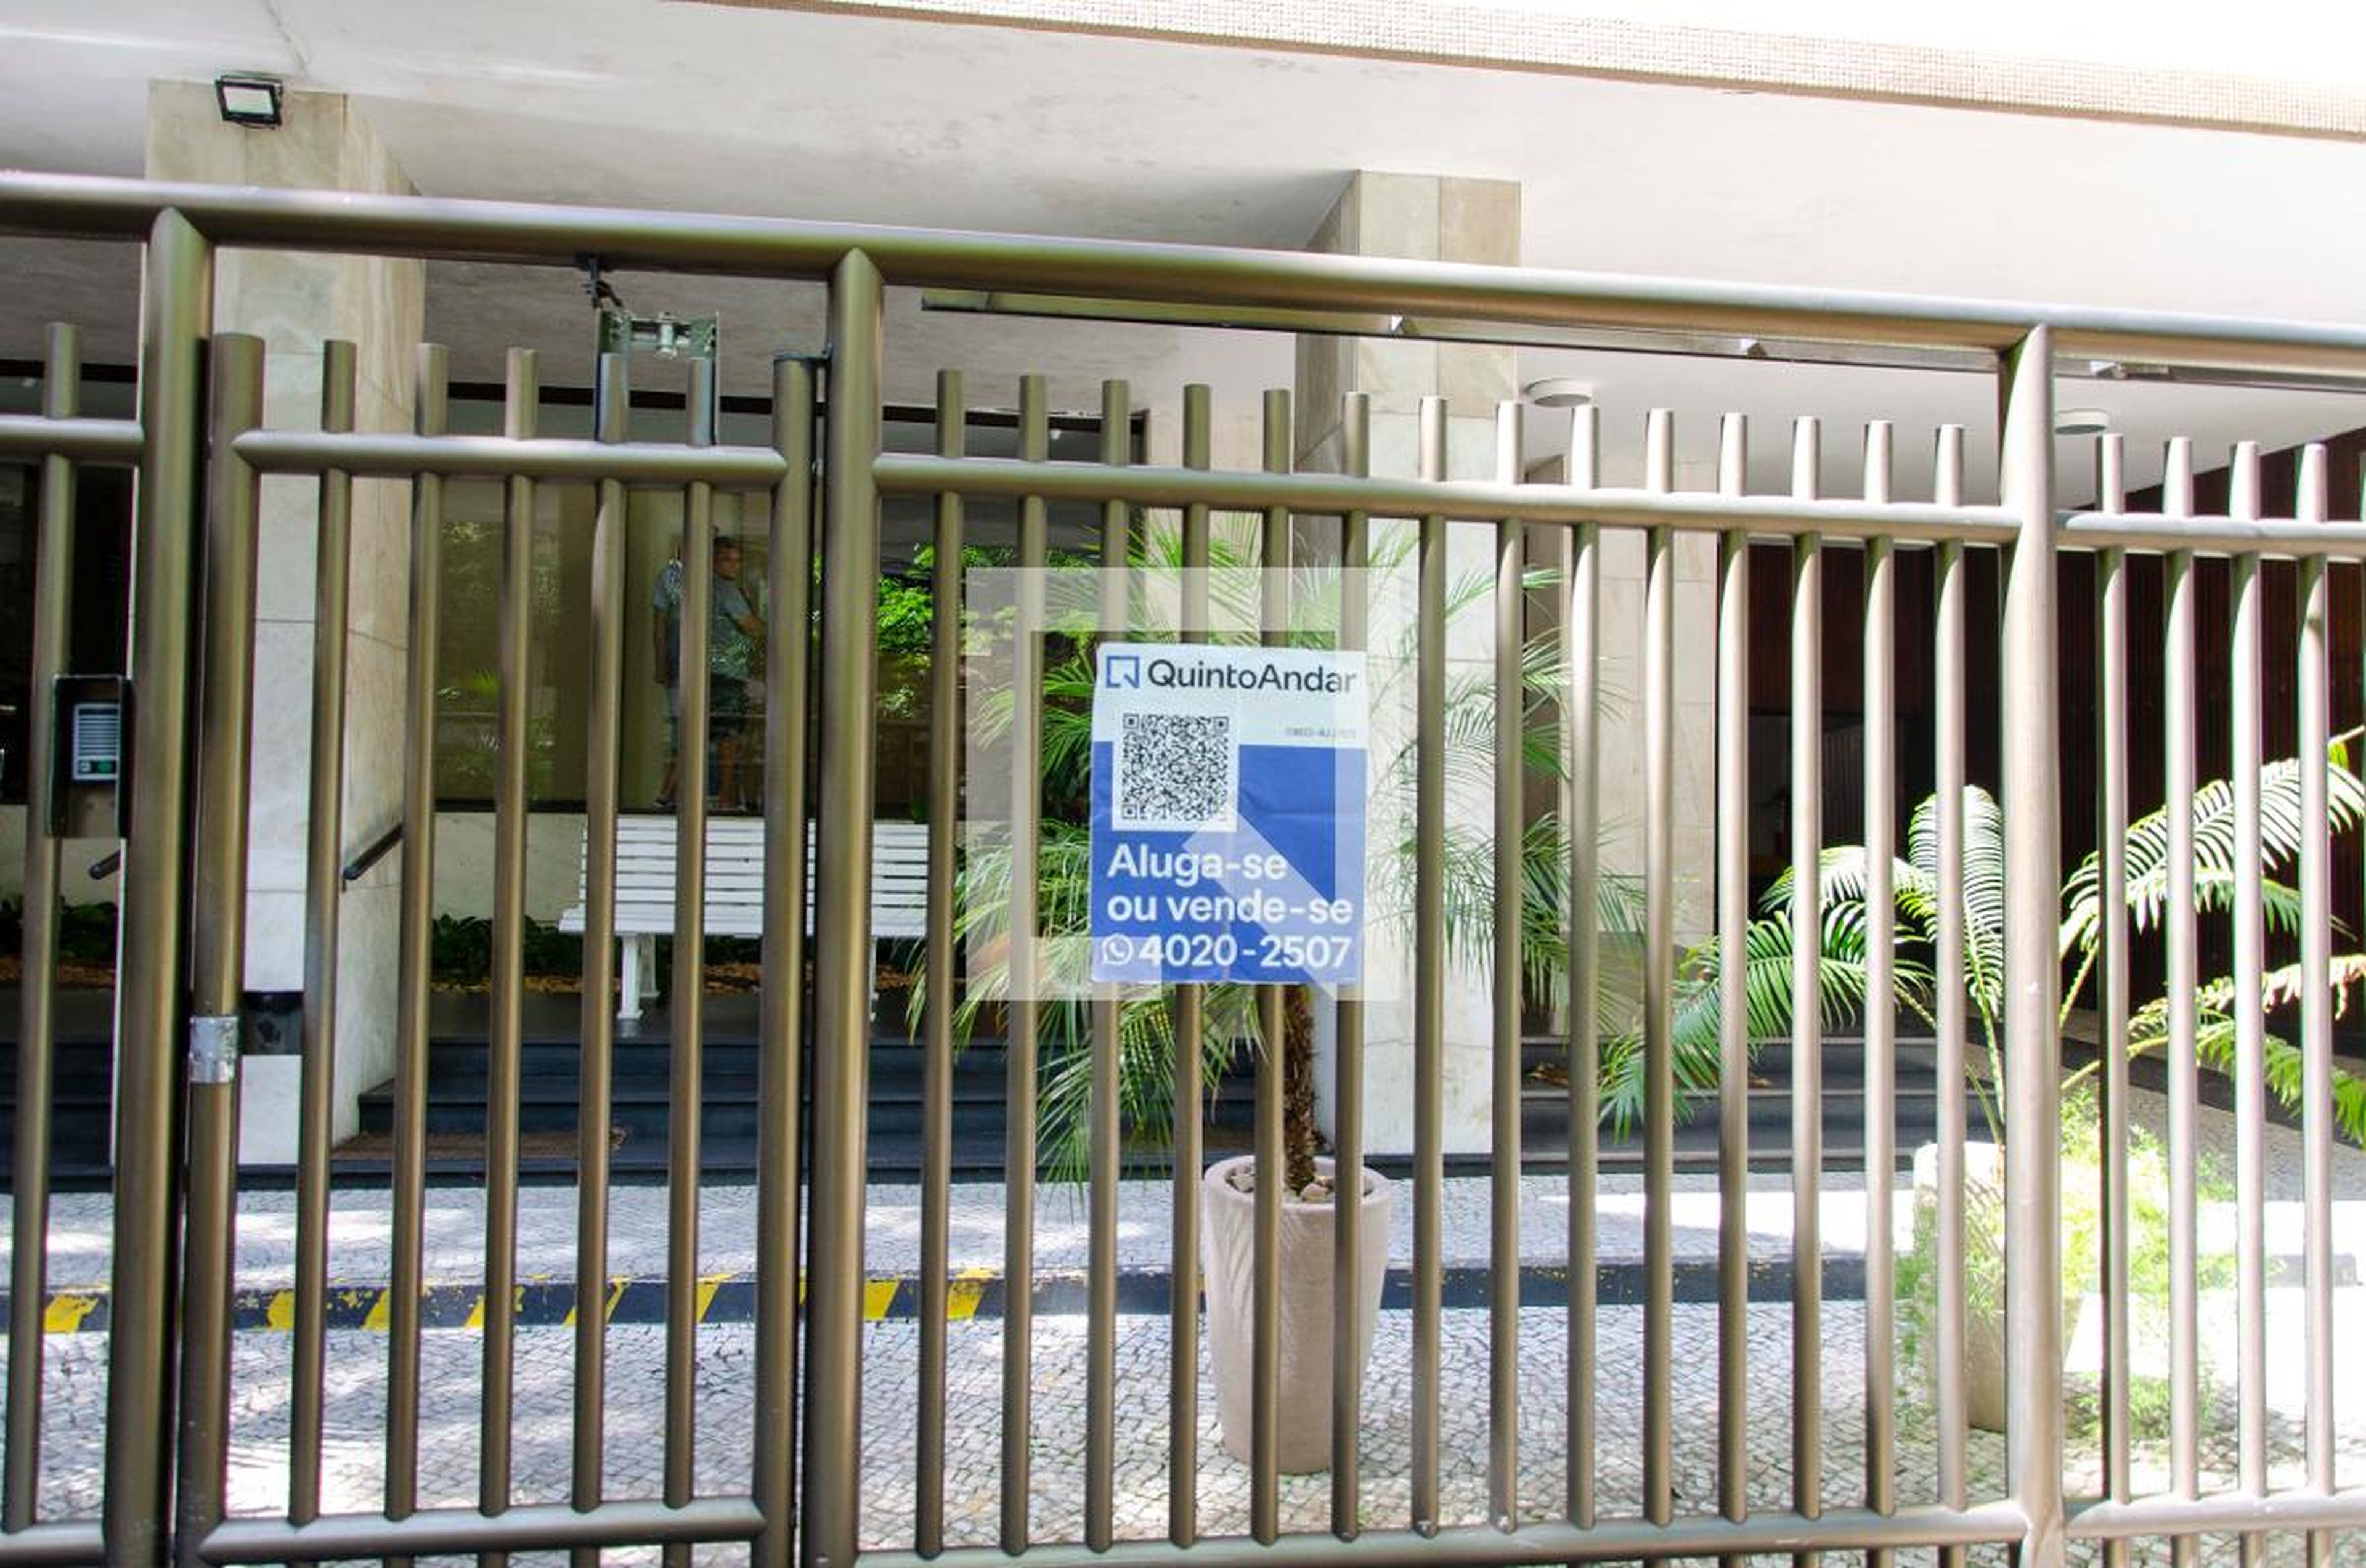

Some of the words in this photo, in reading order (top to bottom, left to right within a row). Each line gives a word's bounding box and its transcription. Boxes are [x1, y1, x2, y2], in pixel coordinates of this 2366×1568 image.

[1148, 659, 1356, 693] QuintoAndar
[1107, 843, 1287, 887] Aluga-se
[1107, 896, 1157, 921] ou
[1168, 890, 1354, 924] vende-se
[1139, 935, 1353, 969] 4020-2507
